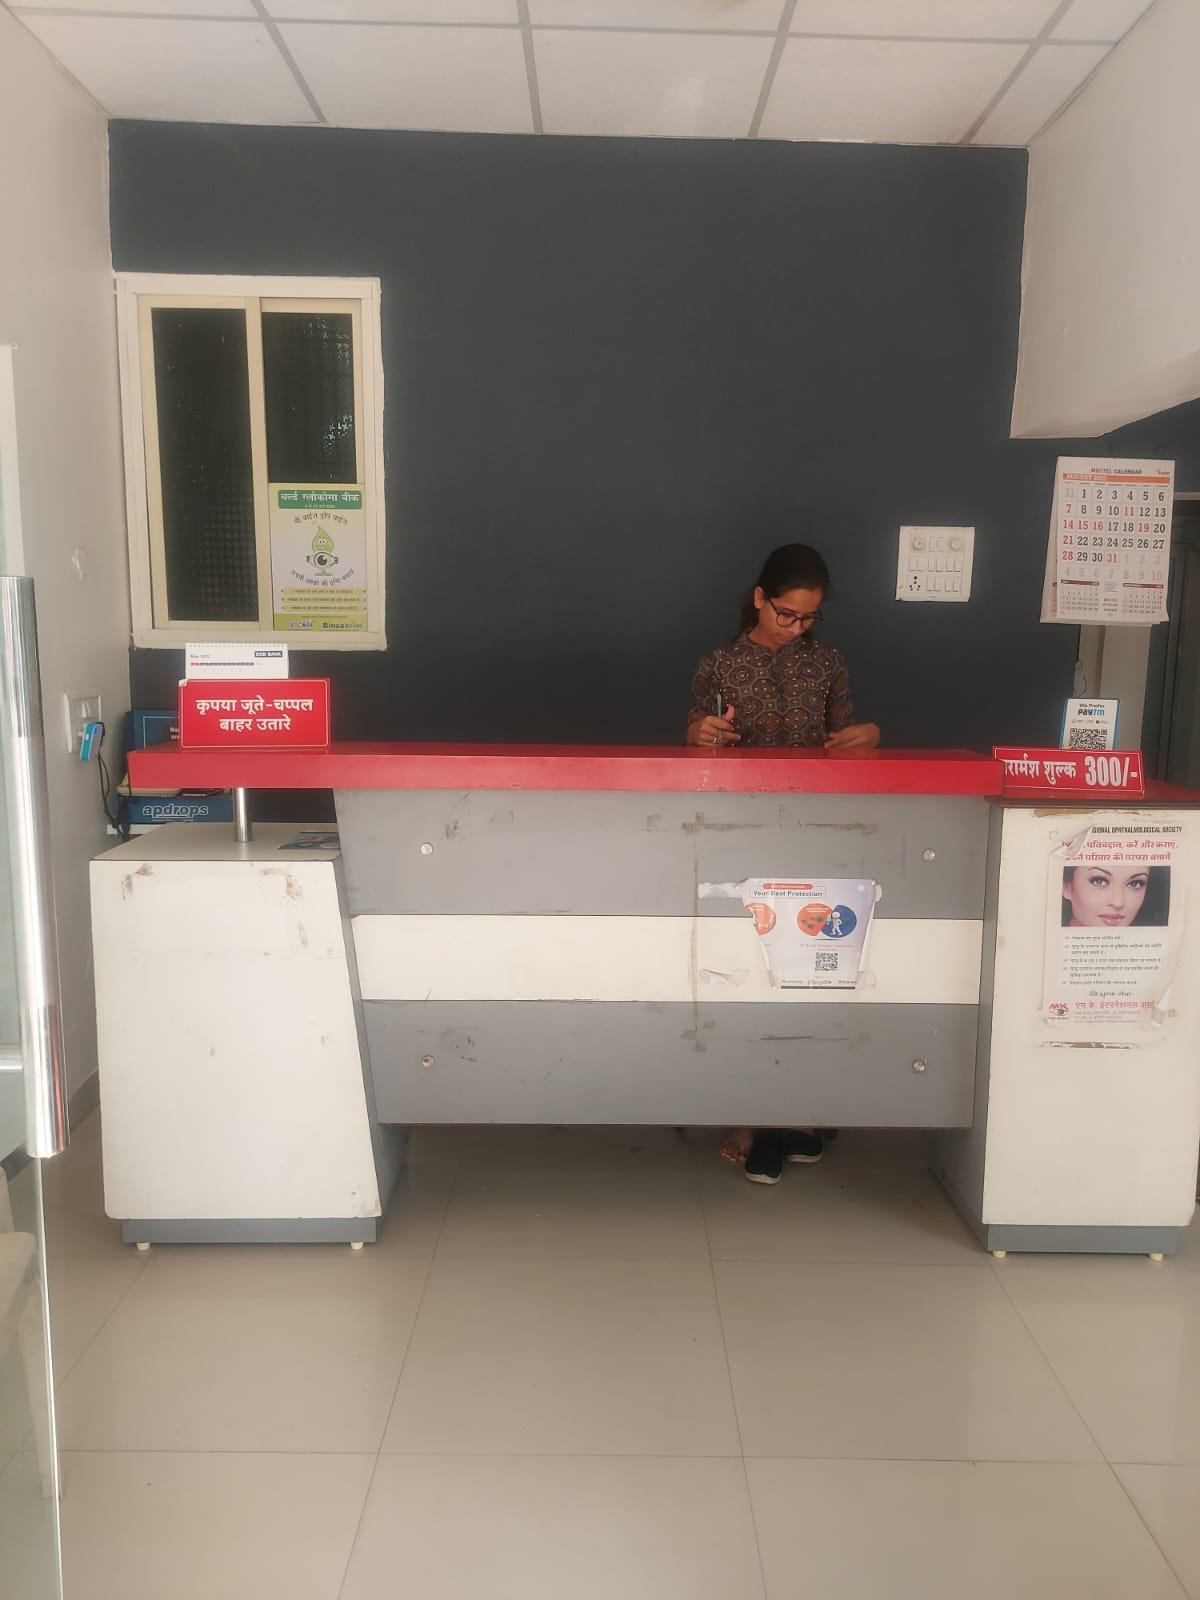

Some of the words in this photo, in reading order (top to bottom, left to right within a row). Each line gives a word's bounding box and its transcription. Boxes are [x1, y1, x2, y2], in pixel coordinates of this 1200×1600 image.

[280, 492, 298, 500] वर्ल्ड
[341, 492, 359, 502] वीक
[1082, 489, 1086, 498] 1
[1097, 490, 1102, 499] 2
[1112, 491, 1118, 500] 3
[1127, 491, 1133, 500] 4
[1143, 491, 1149, 501] 5
[1158, 492, 1164, 501] 6
[1065, 504, 1072, 513] 7
[1081, 505, 1087, 514] 8
[1096, 505, 1102, 515] 9
[1108, 506, 1119, 516] 10
[1124, 507, 1134, 516] 11
[1139, 507, 1150, 517] 12
[1155, 508, 1166, 517] 13
[1063, 520, 1073, 529] 14
[1078, 520, 1088, 530] 15
[1093, 521, 1103, 531] 16
[1108, 522, 1119, 531] 17
[1123, 522, 1134, 532] 18
[1138, 523, 1149, 532] 19
[1153, 523, 1165, 533] 20
[1063, 535, 1073, 545] 21
[1077, 536, 1088, 546] 22
[1092, 537, 1103, 546] 23
[1107, 537, 1118, 547] 24
[1122, 538, 1133, 548] 25
[1137, 539, 1149, 548] 26
[1152, 539, 1164, 549] 27
[1062, 551, 1073, 560] 28
[1077, 552, 1088, 561] 29
[1092, 552, 1102, 562] 30
[1107, 553, 1117, 563] 31
[195, 699, 237, 715] कृपया
[240, 695, 314, 715] जूते-चप्पल
[219, 719, 253, 732] बाहर
[256, 714, 292, 730] उतारे
[1044, 762, 1076, 785] शुल्क
[1085, 756, 1138, 787] 300/-
[142, 803, 208, 818] apdrops
[1113, 853, 1123, 861] की
[1141, 1000, 1155, 1009] आई
